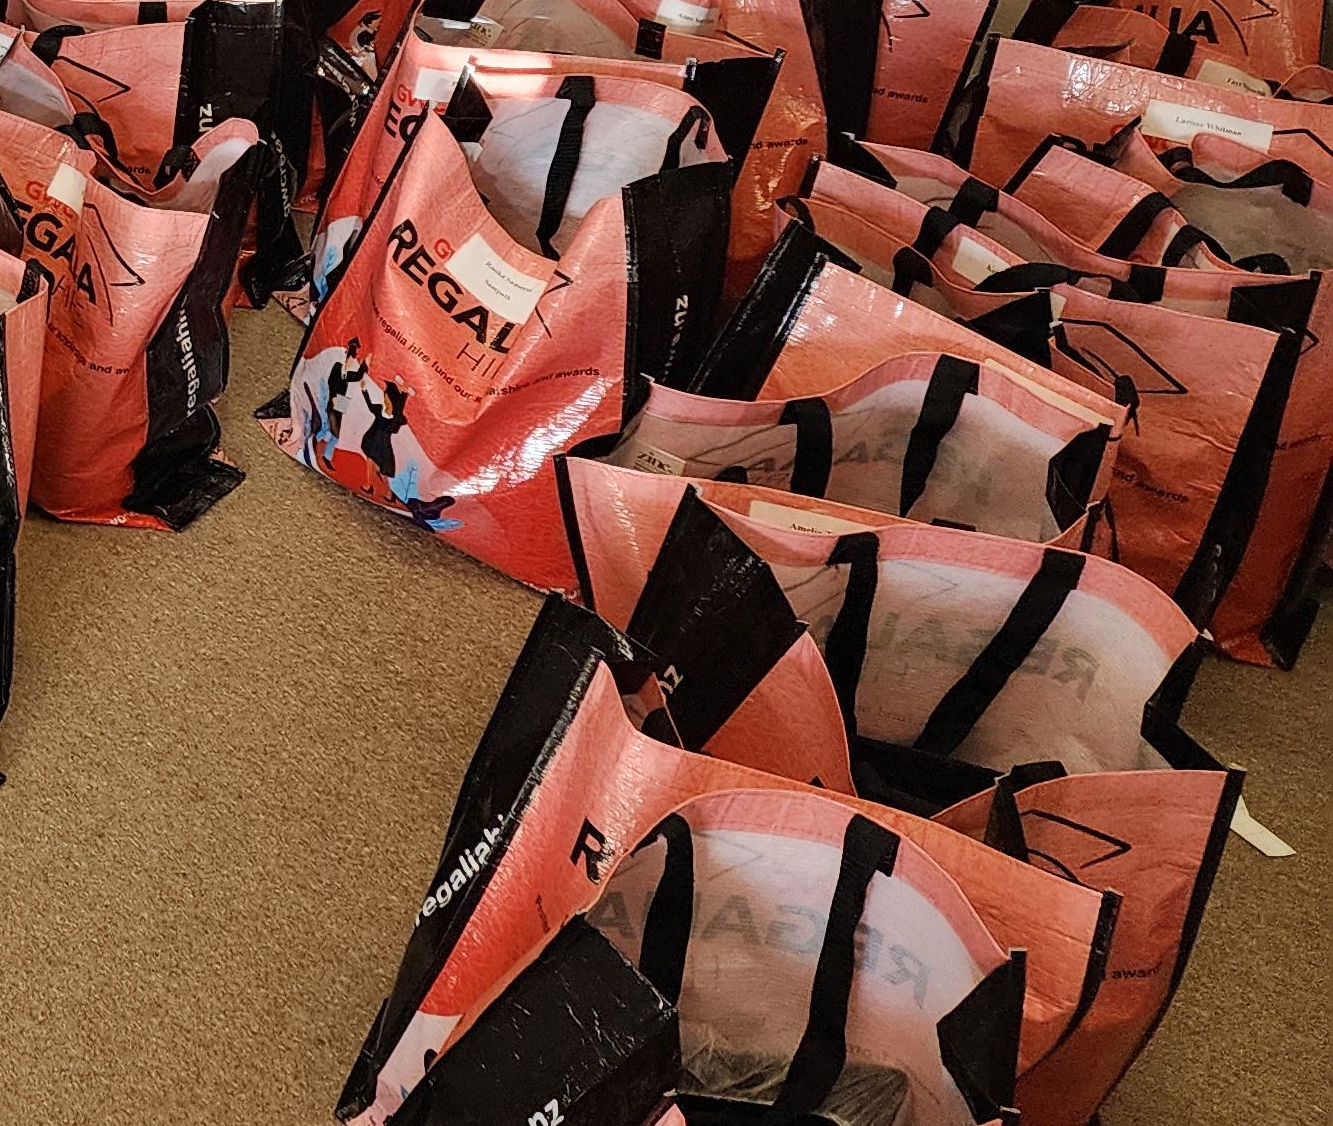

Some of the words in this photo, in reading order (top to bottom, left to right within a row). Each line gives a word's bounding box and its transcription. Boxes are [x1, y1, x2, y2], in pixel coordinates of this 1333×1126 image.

[887, 90, 929, 105] awards
[386, 219, 515, 355] REGAL
[379, 316, 407, 347] regalia
[431, 360, 454, 385] fund
[453, 384, 473, 401] our
[553, 366, 600, 381] awards
